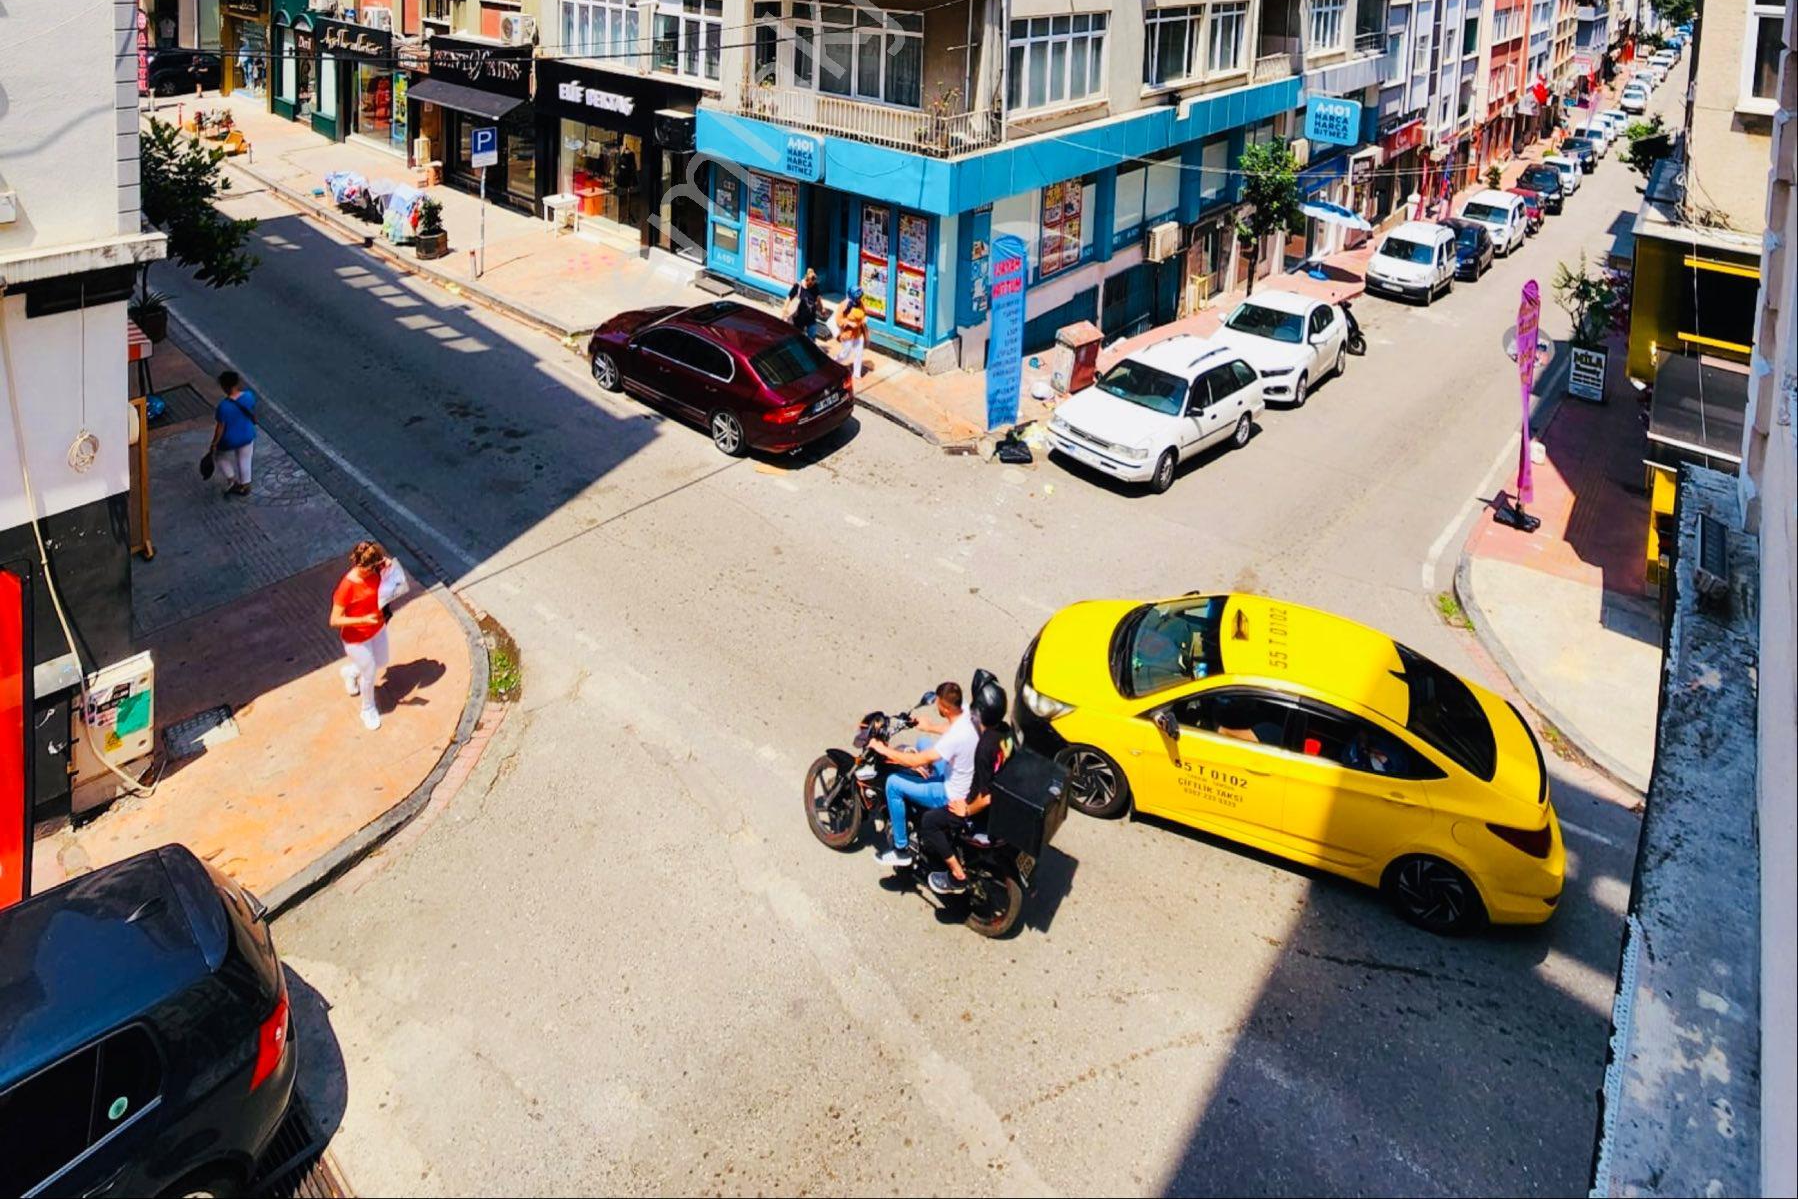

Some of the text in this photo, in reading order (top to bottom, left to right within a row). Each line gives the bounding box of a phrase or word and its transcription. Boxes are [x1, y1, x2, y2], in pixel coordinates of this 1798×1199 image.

[1314, 112, 1349, 125] HARCA
[1314, 121, 1349, 133] HARCA
[476, 131, 492, 151] P
[1269, 607, 1288, 637] 0102
[1268, 651, 1288, 670] 55
[1174, 758, 1192, 773] 55
[1198, 764, 1206, 776] T
[1210, 768, 1249, 790] 0102
